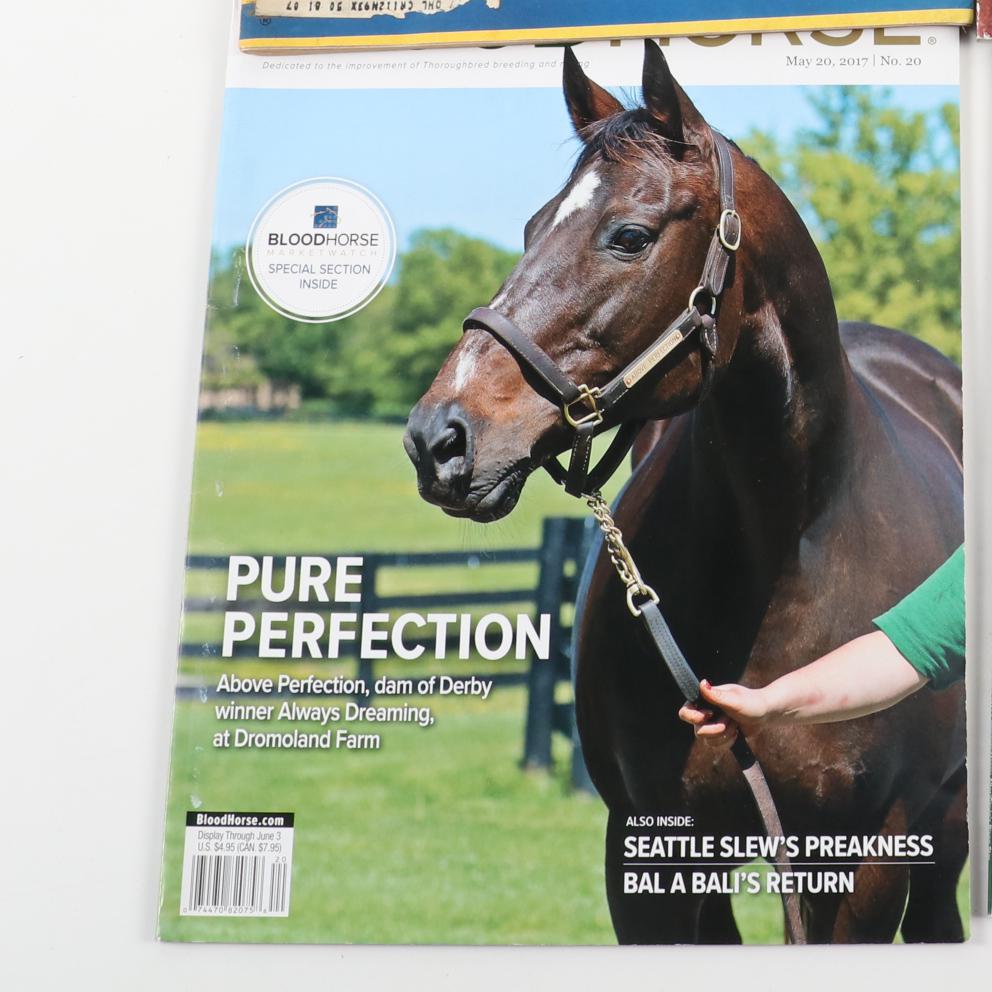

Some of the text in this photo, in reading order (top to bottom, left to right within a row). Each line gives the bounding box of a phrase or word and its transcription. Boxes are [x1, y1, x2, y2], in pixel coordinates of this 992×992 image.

[262, 60, 557, 71] Dedicated to the improvement of Thoroughbred breeding and
[786, 56, 922, 68] May 20, 2017 No. 20
[268, 233, 379, 247] BLOODHORSE
[268, 263, 371, 275] SPECIAL SECTION
[299, 279, 338, 290] INSIDE
[226, 555, 364, 603] PURE
[221, 610, 552, 661] PERFECTION
[216, 674, 493, 699] Above Perfection, dam of Derby
[215, 701, 435, 727] winner Always Dreaming,
[213, 729, 380, 750] at Dromoland Farm
[196, 813, 284, 826] BloodHorse.com
[626, 816, 695, 827] ALSO INSIDE:
[198, 831, 281, 841] Display Through June 3
[198, 842, 211, 852] U.S.
[214, 842, 235, 852] $4.95
[258, 843, 282, 853] $7.95)
[623, 834, 934, 858] SEATTLE SLEW'S PREAKNESS
[623, 871, 855, 894] BAL A BALI'S RETURN
